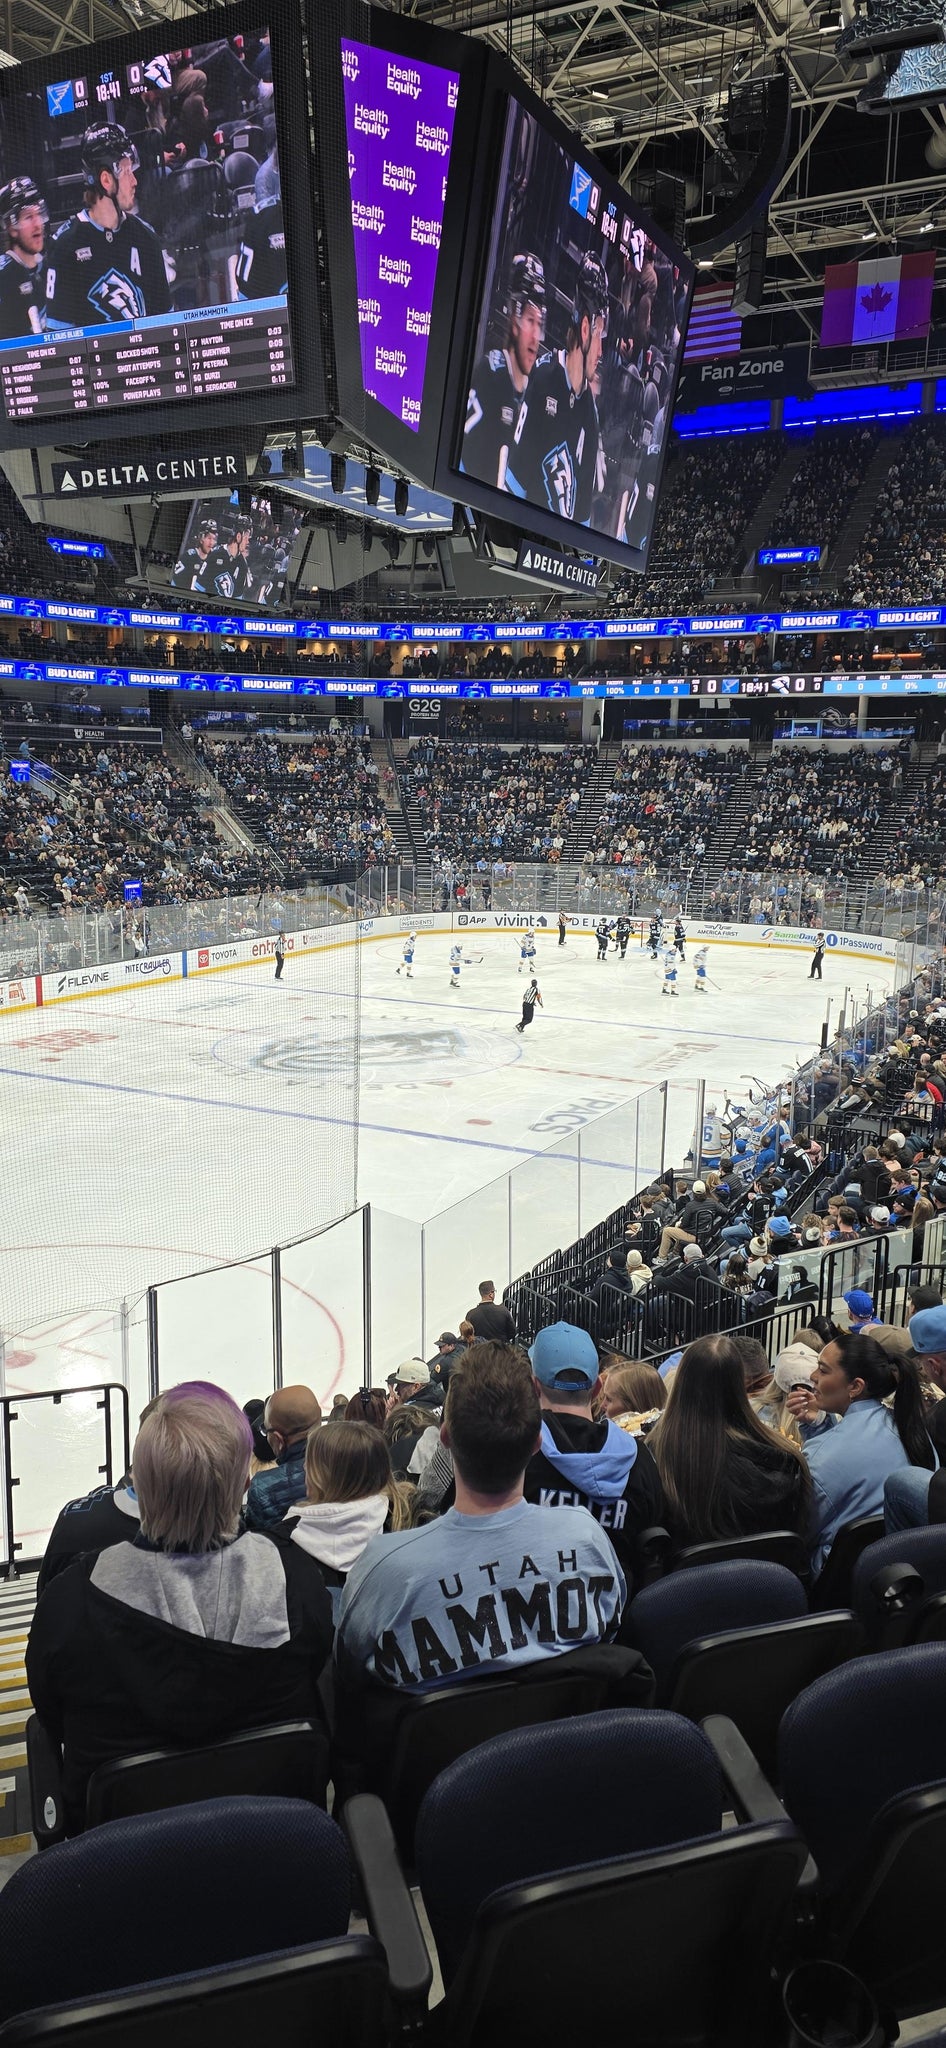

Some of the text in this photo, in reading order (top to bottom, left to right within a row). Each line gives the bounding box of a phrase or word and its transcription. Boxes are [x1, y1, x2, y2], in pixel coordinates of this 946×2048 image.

[100, 72, 113, 83] 1ST
[131, 66, 140, 83] 0
[387, 62, 420, 84] Health
[76, 81, 84, 97] 0
[96, 81, 120, 102] 18:41
[386, 77, 421, 99] Equity
[354, 103, 388, 124] Health
[354, 117, 389, 139] Equity
[416, 120, 448, 142] Health
[415, 134, 449, 156] Equity
[383, 160, 416, 180] Health
[382, 174, 416, 195] Equity
[591, 186, 598, 210] 0
[351, 200, 384, 220] Health
[608, 202, 617, 218] 1ST
[351, 214, 385, 235] Equity
[412, 215, 442, 234] Health
[601, 211, 618, 243] 18:41
[623, 220, 630, 242] 0
[411, 228, 440, 249] Equity
[131, 247, 142, 276] A
[379, 254, 411, 273] Health
[379, 267, 411, 288] Equity
[184, 307, 228, 319] UTAH MAMMOTH
[220, 318, 254, 330] TIME ON ICE
[53, 332, 66, 340] LOUIS
[68, 329, 84, 338] BLUES
[129, 334, 142, 343] HITS
[190, 327, 282, 347] 27 HAYTON 0:03
[269, 339, 283, 348] 0:09
[116, 349, 140, 359] BLOCKED
[141, 346, 159, 356] SHOTS
[376, 346, 406, 363] Health
[118, 364, 132, 373] SHOT
[132, 360, 161, 371] ATTEMPTS
[203, 359, 228, 369] PETERKA
[375, 359, 407, 377] Equity
[701, 360, 784, 381] Fan Zone
[93, 381, 109, 390] 100%
[126, 377, 149, 386] FACEOFF
[175, 371, 185, 379] 0%
[97, 385, 187, 403] 0/0 POWER PLAYS 0/0
[82, 456, 237, 488] DELTA CENTER
[534, 553, 597, 588] DELTA CENTER
[48, 605, 95, 619] BUD LIGHT
[131, 613, 180, 626] BUD LIGHT
[880, 612, 939, 623] BUD LIGHT
[245, 622, 295, 633] BUD LIGHT
[606, 623, 656, 633] BUD LIGHT
[692, 619, 744, 629] BUD LIGHT
[782, 616, 838, 627] BUD LIGHT
[330, 626, 379, 636] BUD LIGHT
[414, 627, 462, 637] BUD LIGHT
[496, 626, 544, 636] BUD LIGHT
[48, 668, 95, 680] BUD LIGHT
[130, 674, 179, 685] BUD LIGHT
[243, 680, 292, 690] BUD LIGHT
[327, 683, 376, 693] BUD LIGHT
[410, 685, 459, 694] BUD LIGHT
[492, 685, 540, 694] BUD LIGHT
[707, 680, 716, 692] 0
[742, 682, 769, 692] 18:41
[795, 678, 805, 691] 0
[409, 699, 440, 712] G2G
[252, 937, 294, 956] entrta
[840, 937, 882, 950] 1Password
[212, 948, 237, 960] TOYOTA
[68, 972, 109, 988] FILEVINE
[704, 1126, 713, 1142] 6
[540, 1488, 628, 1530] KEER
[438, 1549, 577, 1599] UTAH
[374, 1575, 620, 1686] MAMMOT
